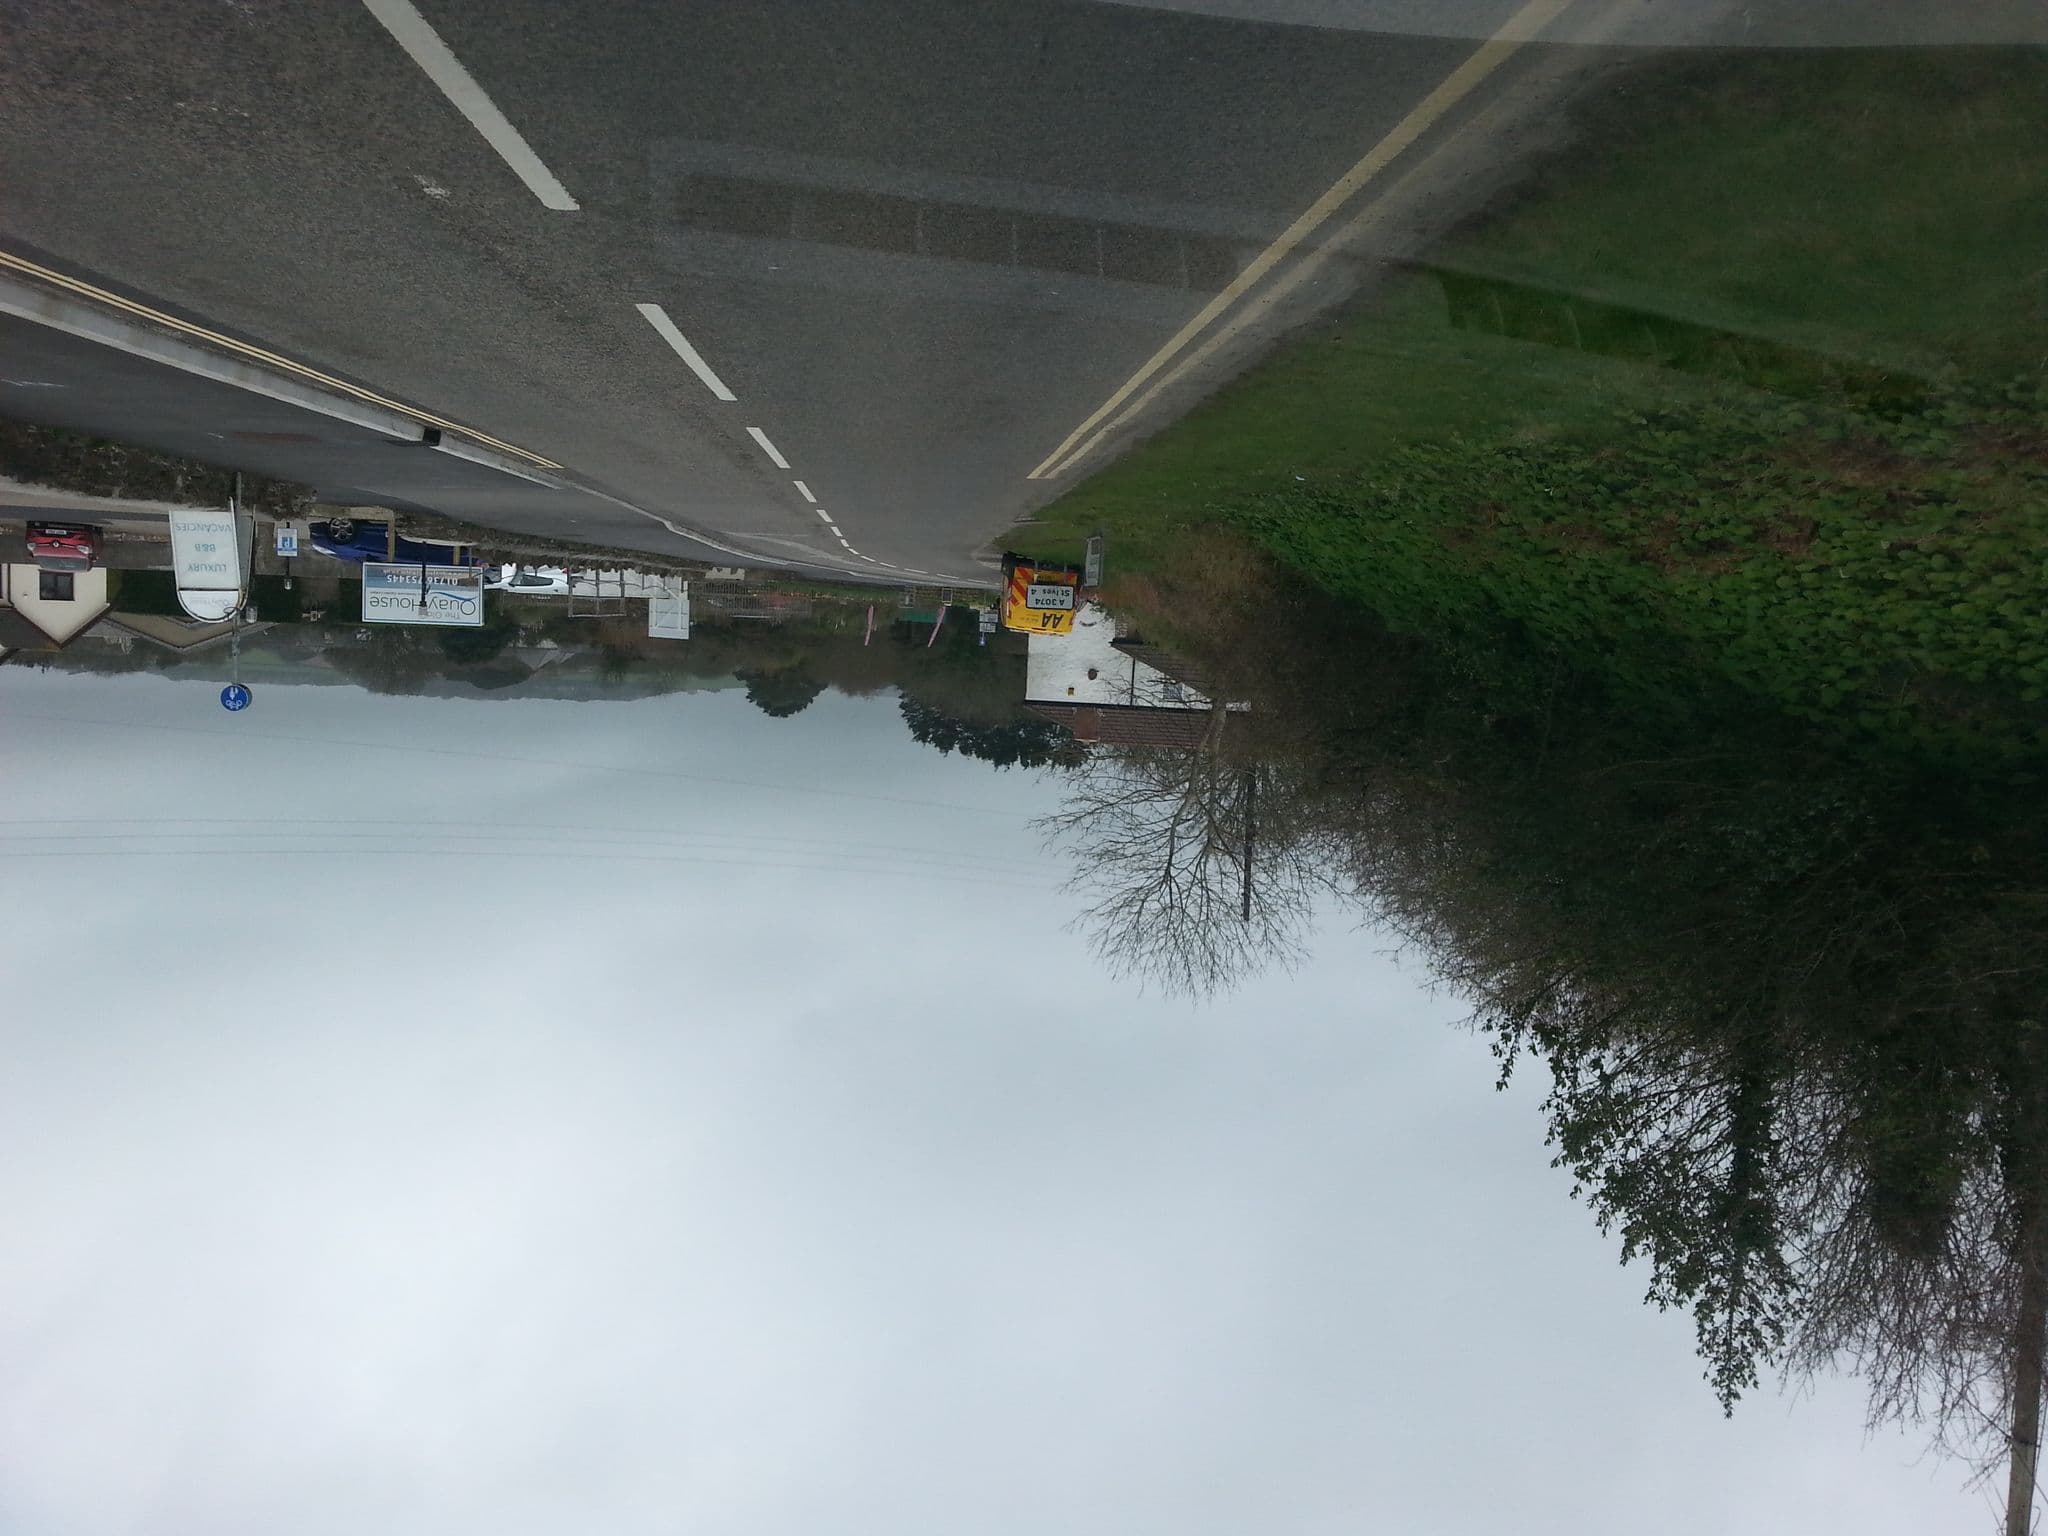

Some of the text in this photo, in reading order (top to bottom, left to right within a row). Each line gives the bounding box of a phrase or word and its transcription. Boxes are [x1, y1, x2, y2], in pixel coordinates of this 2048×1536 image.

[175, 523, 232, 532] VACANCIES
[194, 544, 216, 552] B&B
[188, 563, 226, 572] LUXURY
[386, 575, 458, 585] 01736 753445
[370, 597, 475, 615] Quay House
[1042, 613, 1064, 628] AA
